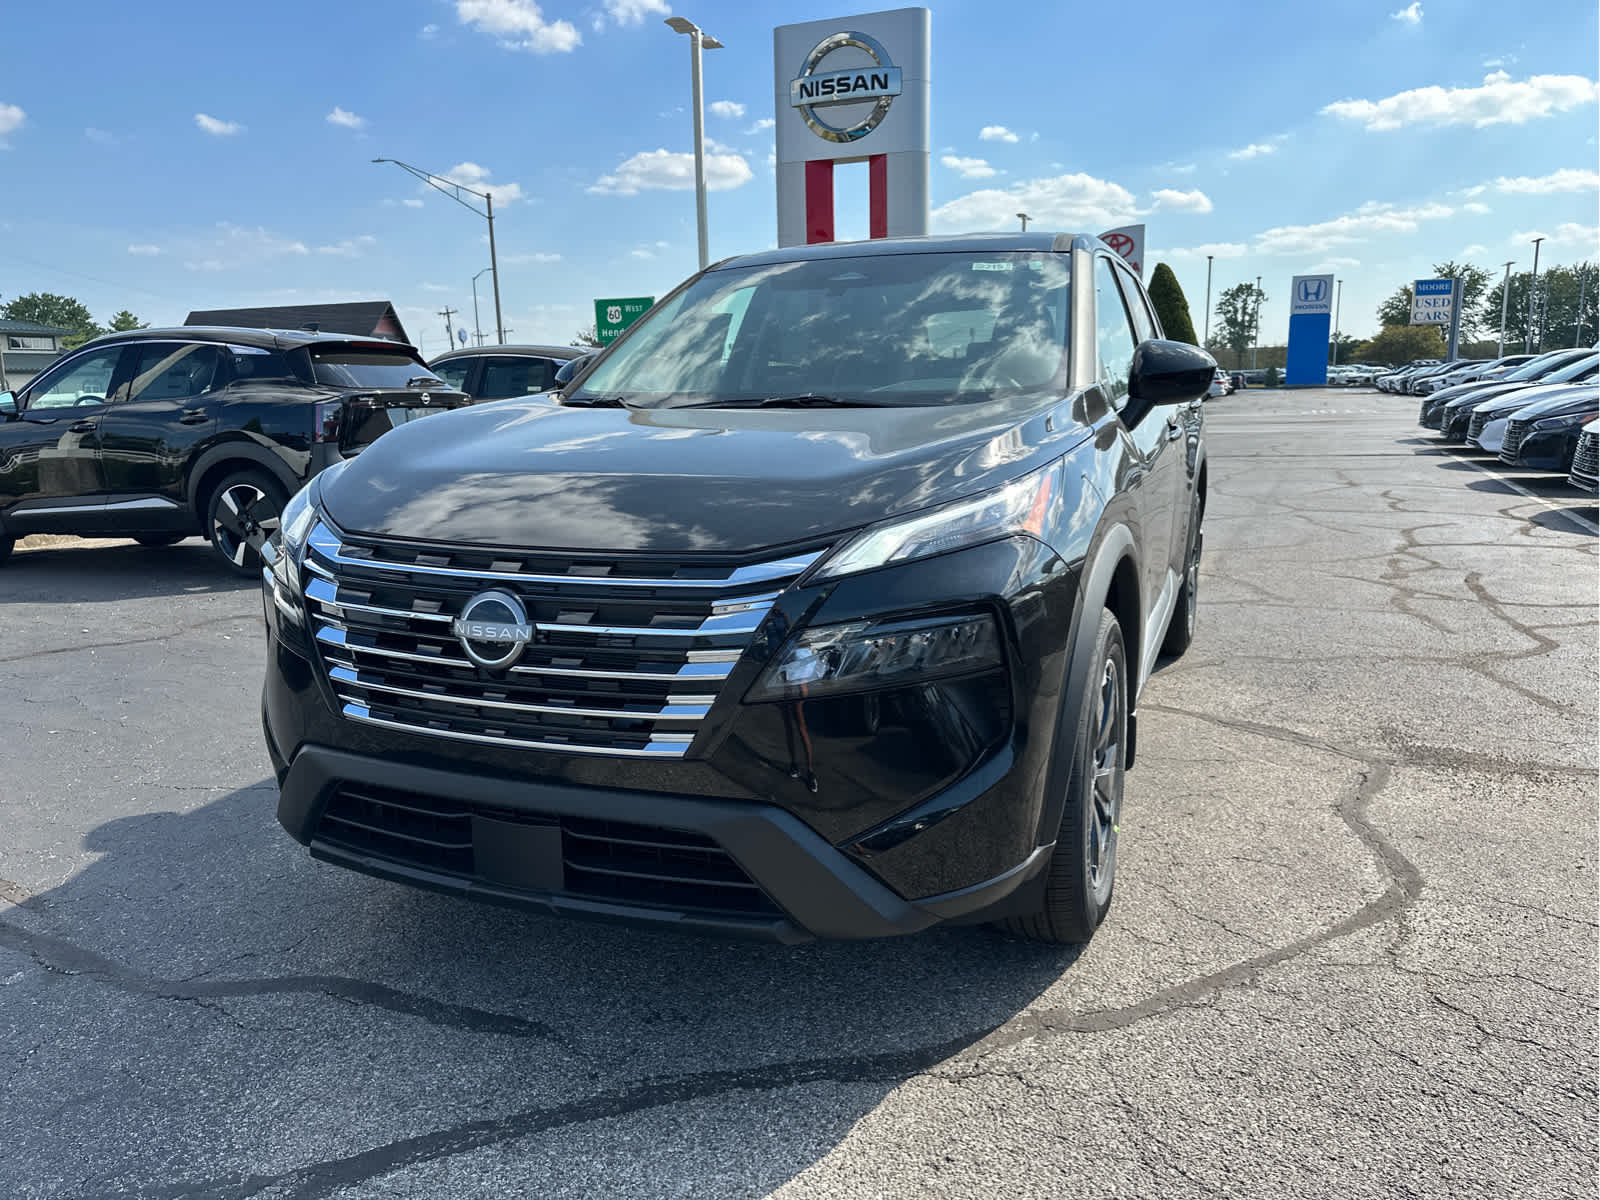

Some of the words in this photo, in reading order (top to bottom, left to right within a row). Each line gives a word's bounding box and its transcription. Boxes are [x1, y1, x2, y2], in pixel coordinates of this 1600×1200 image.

[800, 73, 888, 99] NISSAN
[1415, 297, 1451, 309] USED
[608, 309, 620, 320] 60
[1414, 311, 1449, 321] CARS
[455, 623, 529, 639] NISSAN
